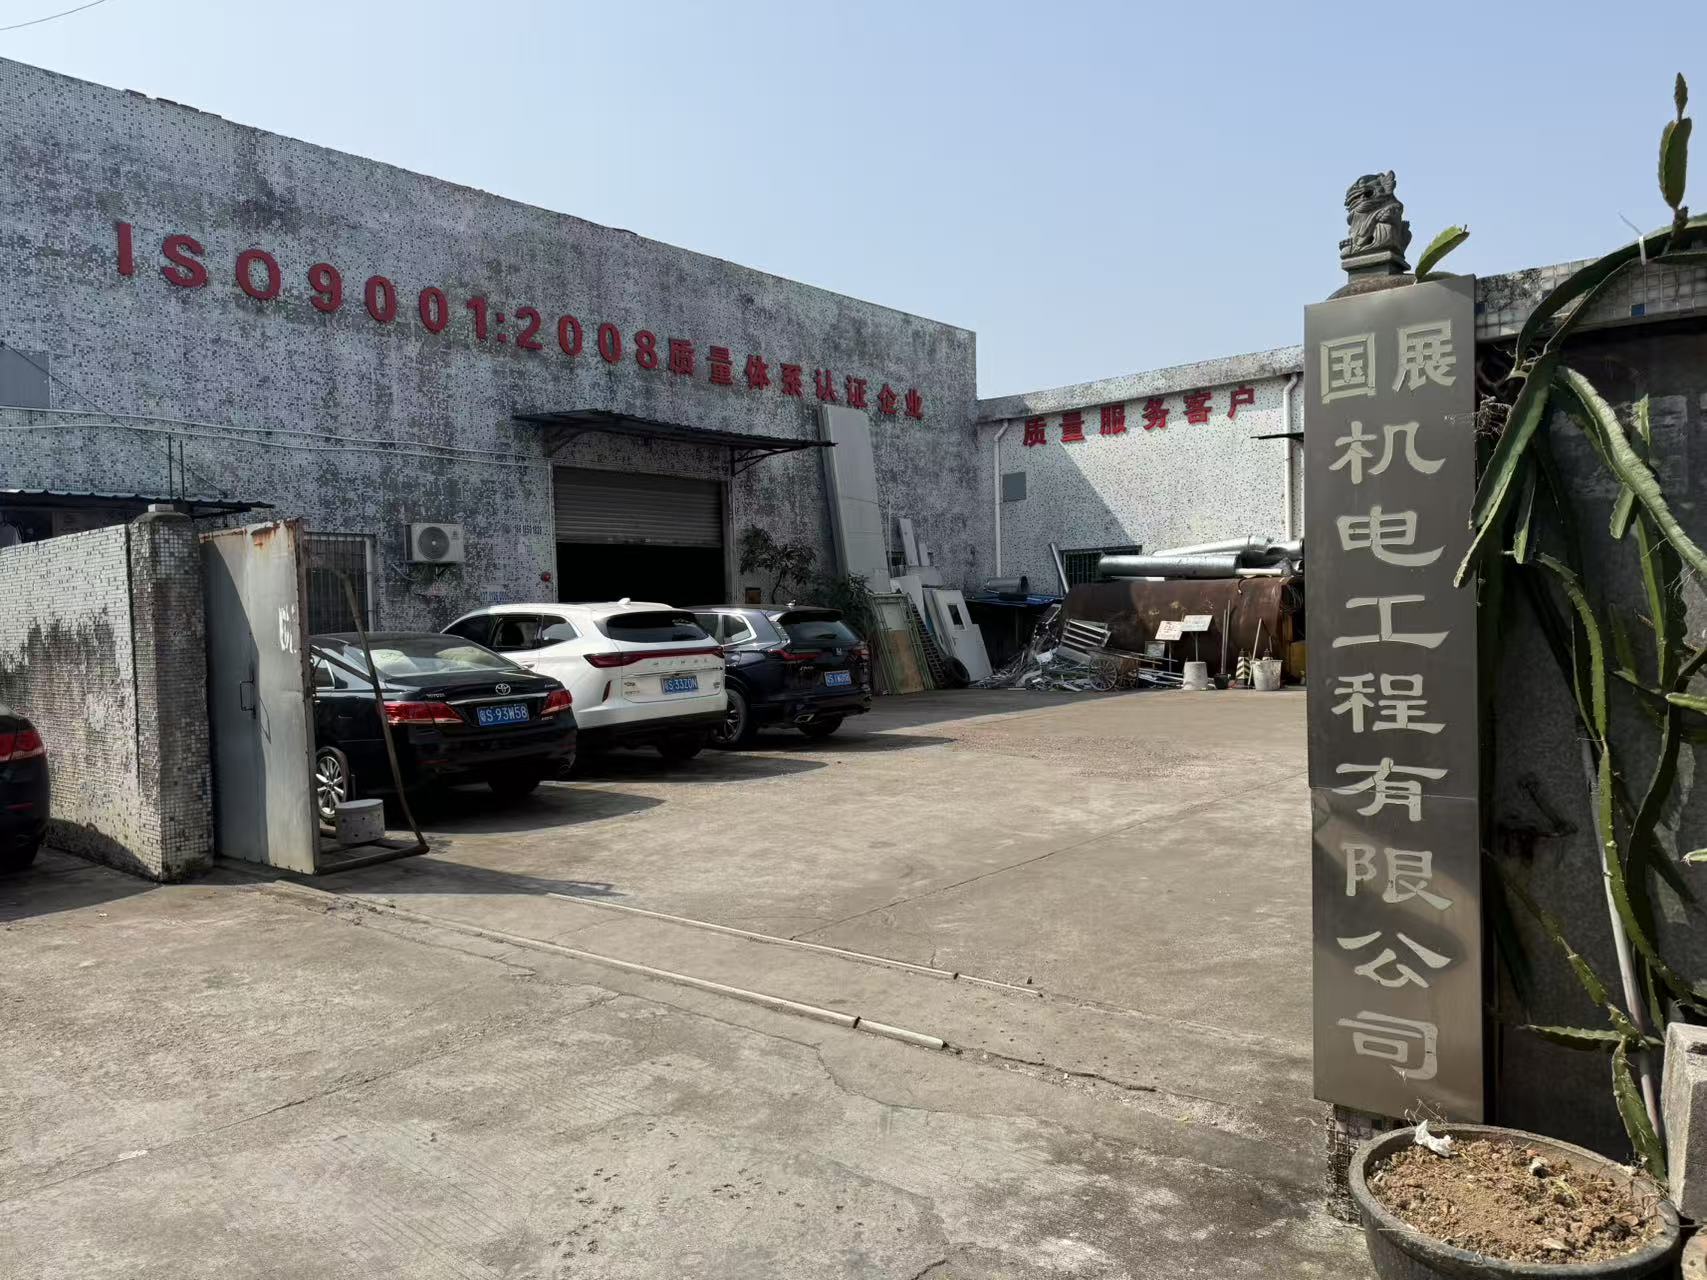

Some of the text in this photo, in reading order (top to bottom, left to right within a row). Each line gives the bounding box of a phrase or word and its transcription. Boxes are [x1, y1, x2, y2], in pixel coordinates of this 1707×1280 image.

[1320, 320, 1457, 404] 国展
[1022, 385, 1255, 447] 质量服务客户
[1329, 421, 1452, 1080] 机电工程有限公司
